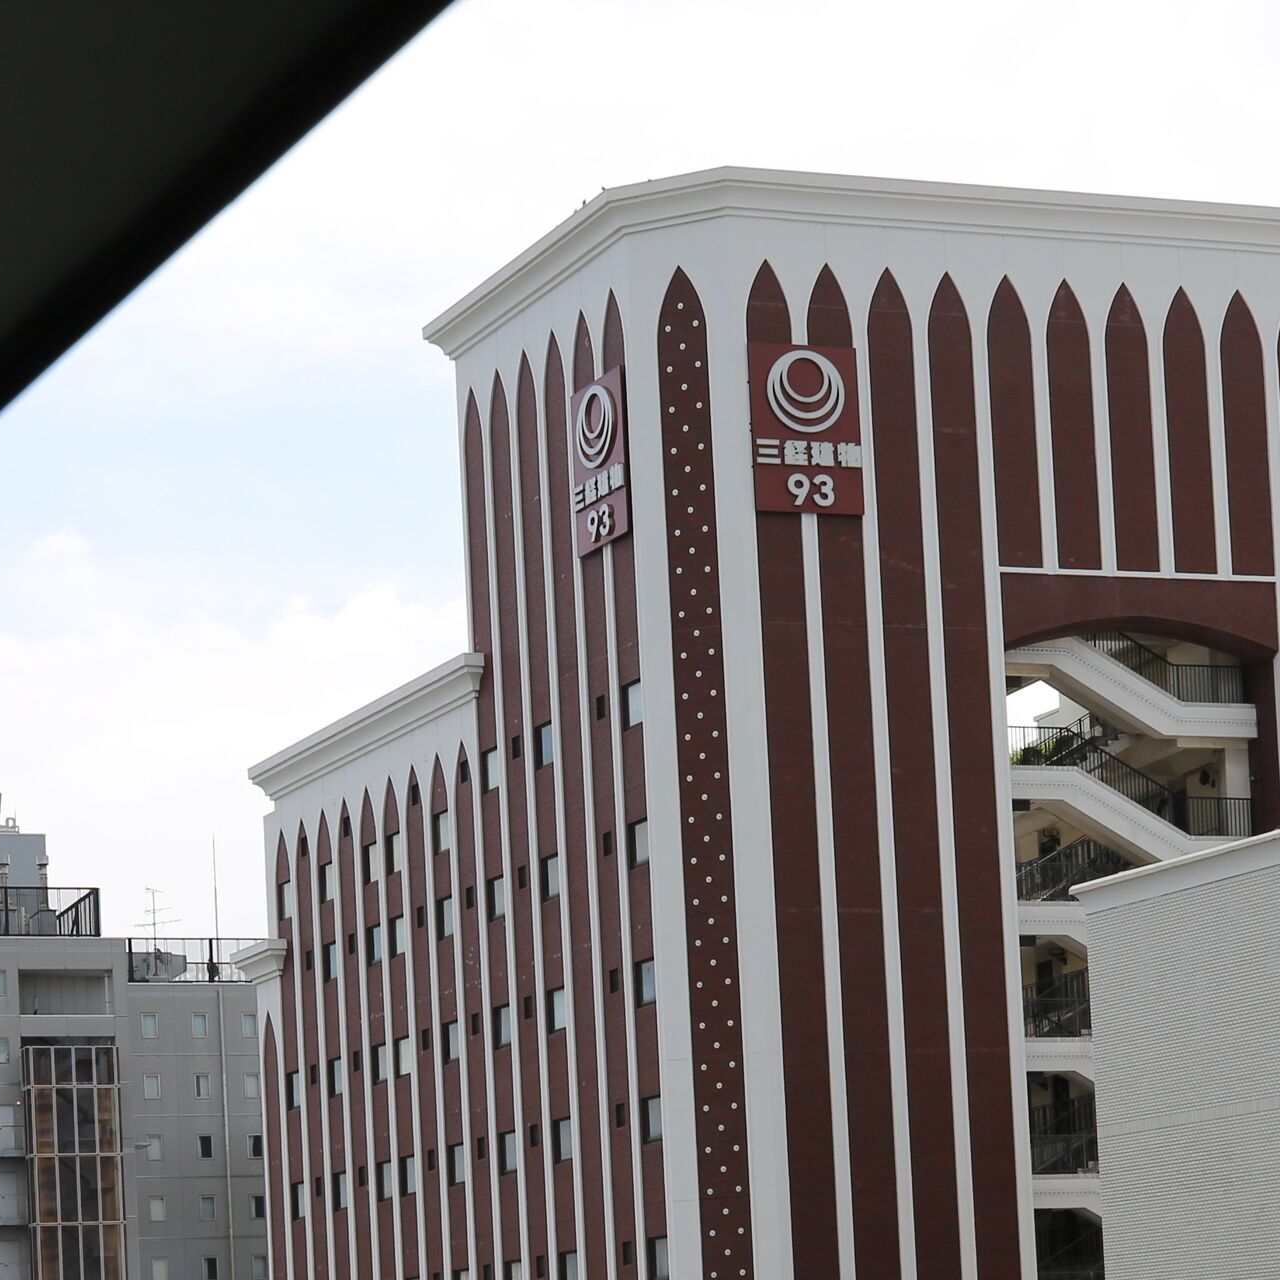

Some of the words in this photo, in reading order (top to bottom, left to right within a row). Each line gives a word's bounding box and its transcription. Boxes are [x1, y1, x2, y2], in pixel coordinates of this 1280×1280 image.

[756, 438, 862, 468] 三経建物
[787, 473, 835, 507] 93
[586, 503, 615, 543] 93
